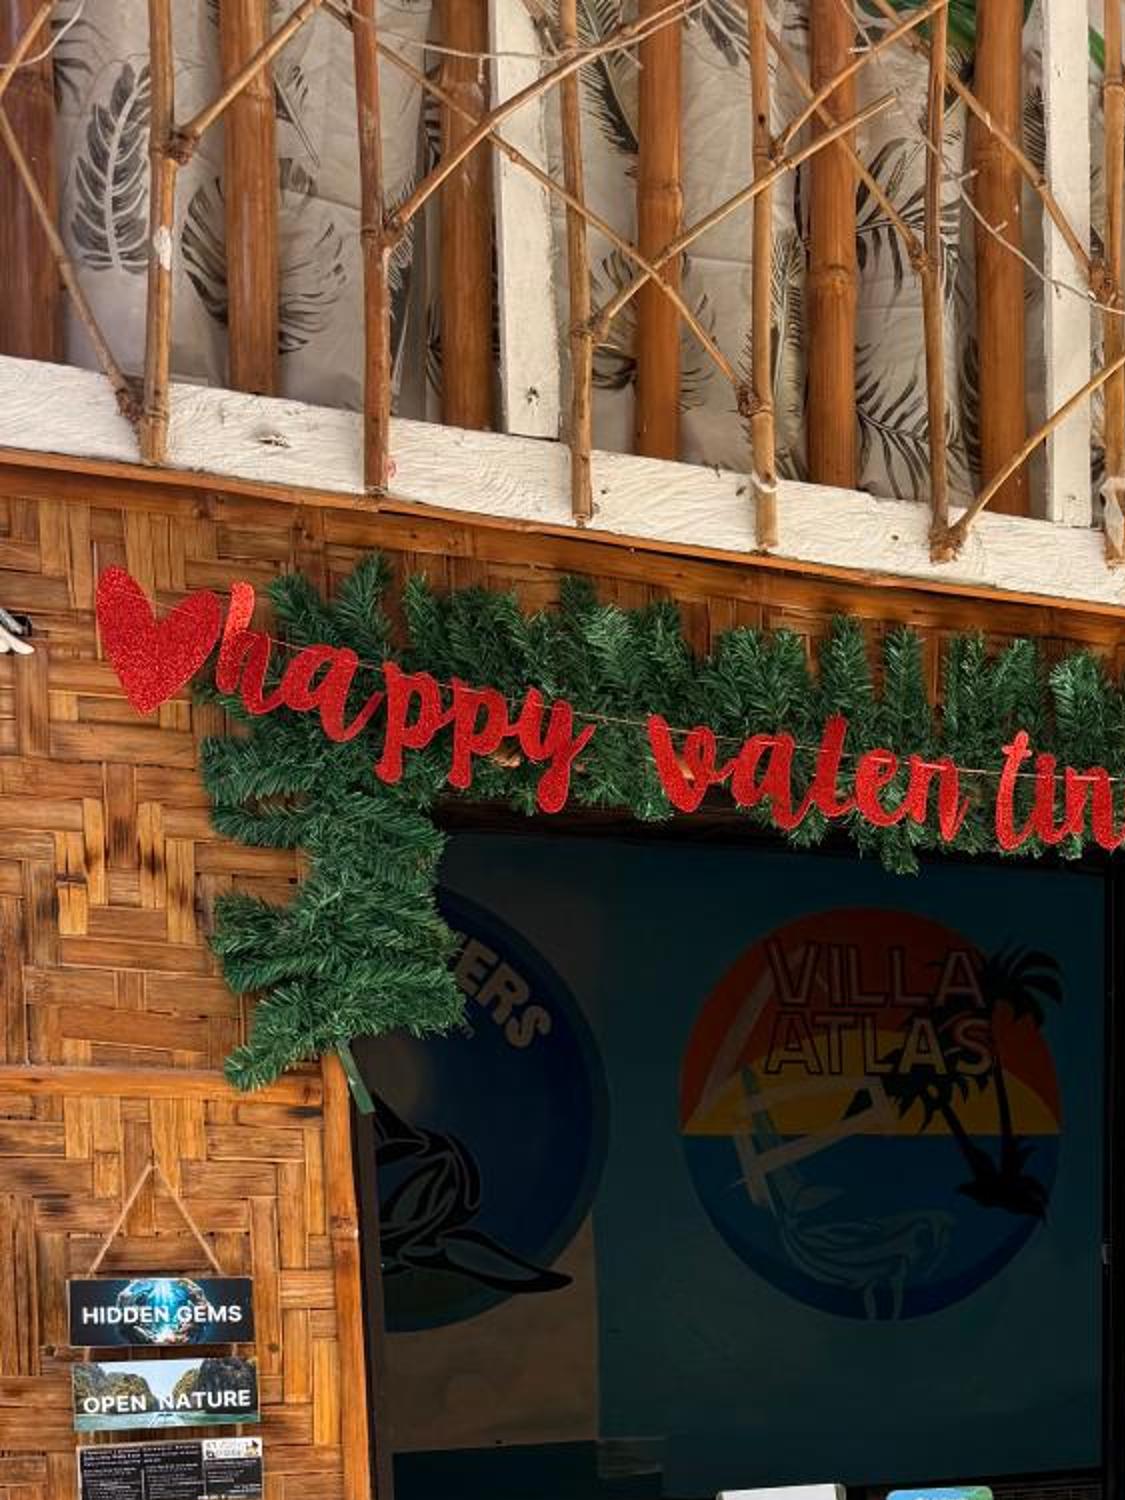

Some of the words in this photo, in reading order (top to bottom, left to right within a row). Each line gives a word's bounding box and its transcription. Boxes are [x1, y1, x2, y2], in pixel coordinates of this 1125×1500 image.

[216, 581, 597, 813] happy
[452, 935, 553, 1050] ERS
[765, 938, 987, 1010] VILLA
[763, 1009, 997, 1076] ATLAS
[82, 1305, 170, 1325] HIDDEN
[176, 1304, 242, 1323] GEMS
[83, 1393, 147, 1413] OPEN
[157, 1389, 251, 1411] NATURE
